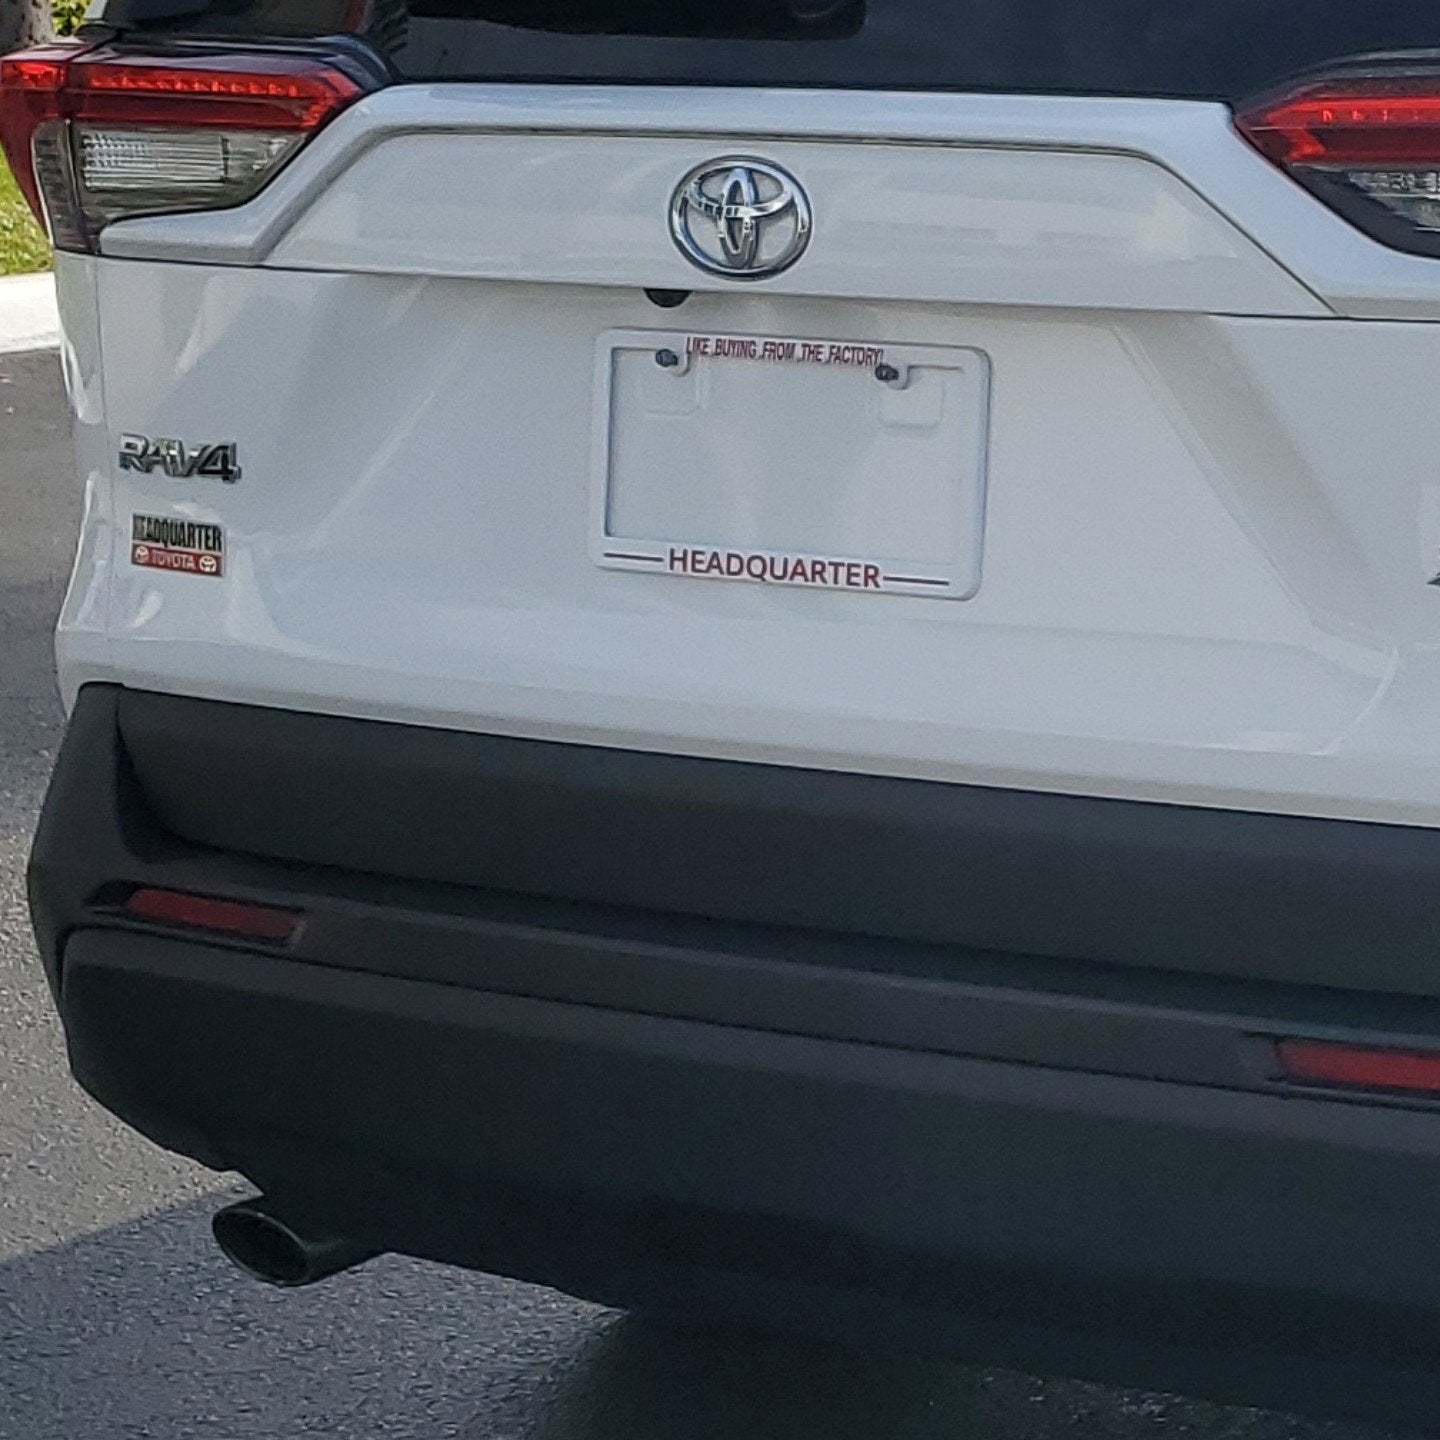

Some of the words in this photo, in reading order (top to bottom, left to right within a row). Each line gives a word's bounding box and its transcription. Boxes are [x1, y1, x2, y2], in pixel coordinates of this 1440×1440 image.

[686, 336, 710, 356] LIKE
[714, 338, 757, 359] BUYING
[762, 341, 796, 361] FROM
[802, 343, 824, 362] THE
[118, 432, 243, 484] RAV4
[133, 514, 222, 551] HEADQUARTER
[151, 550, 197, 570] TOYOTA
[669, 547, 881, 589] HEADQUARTER
